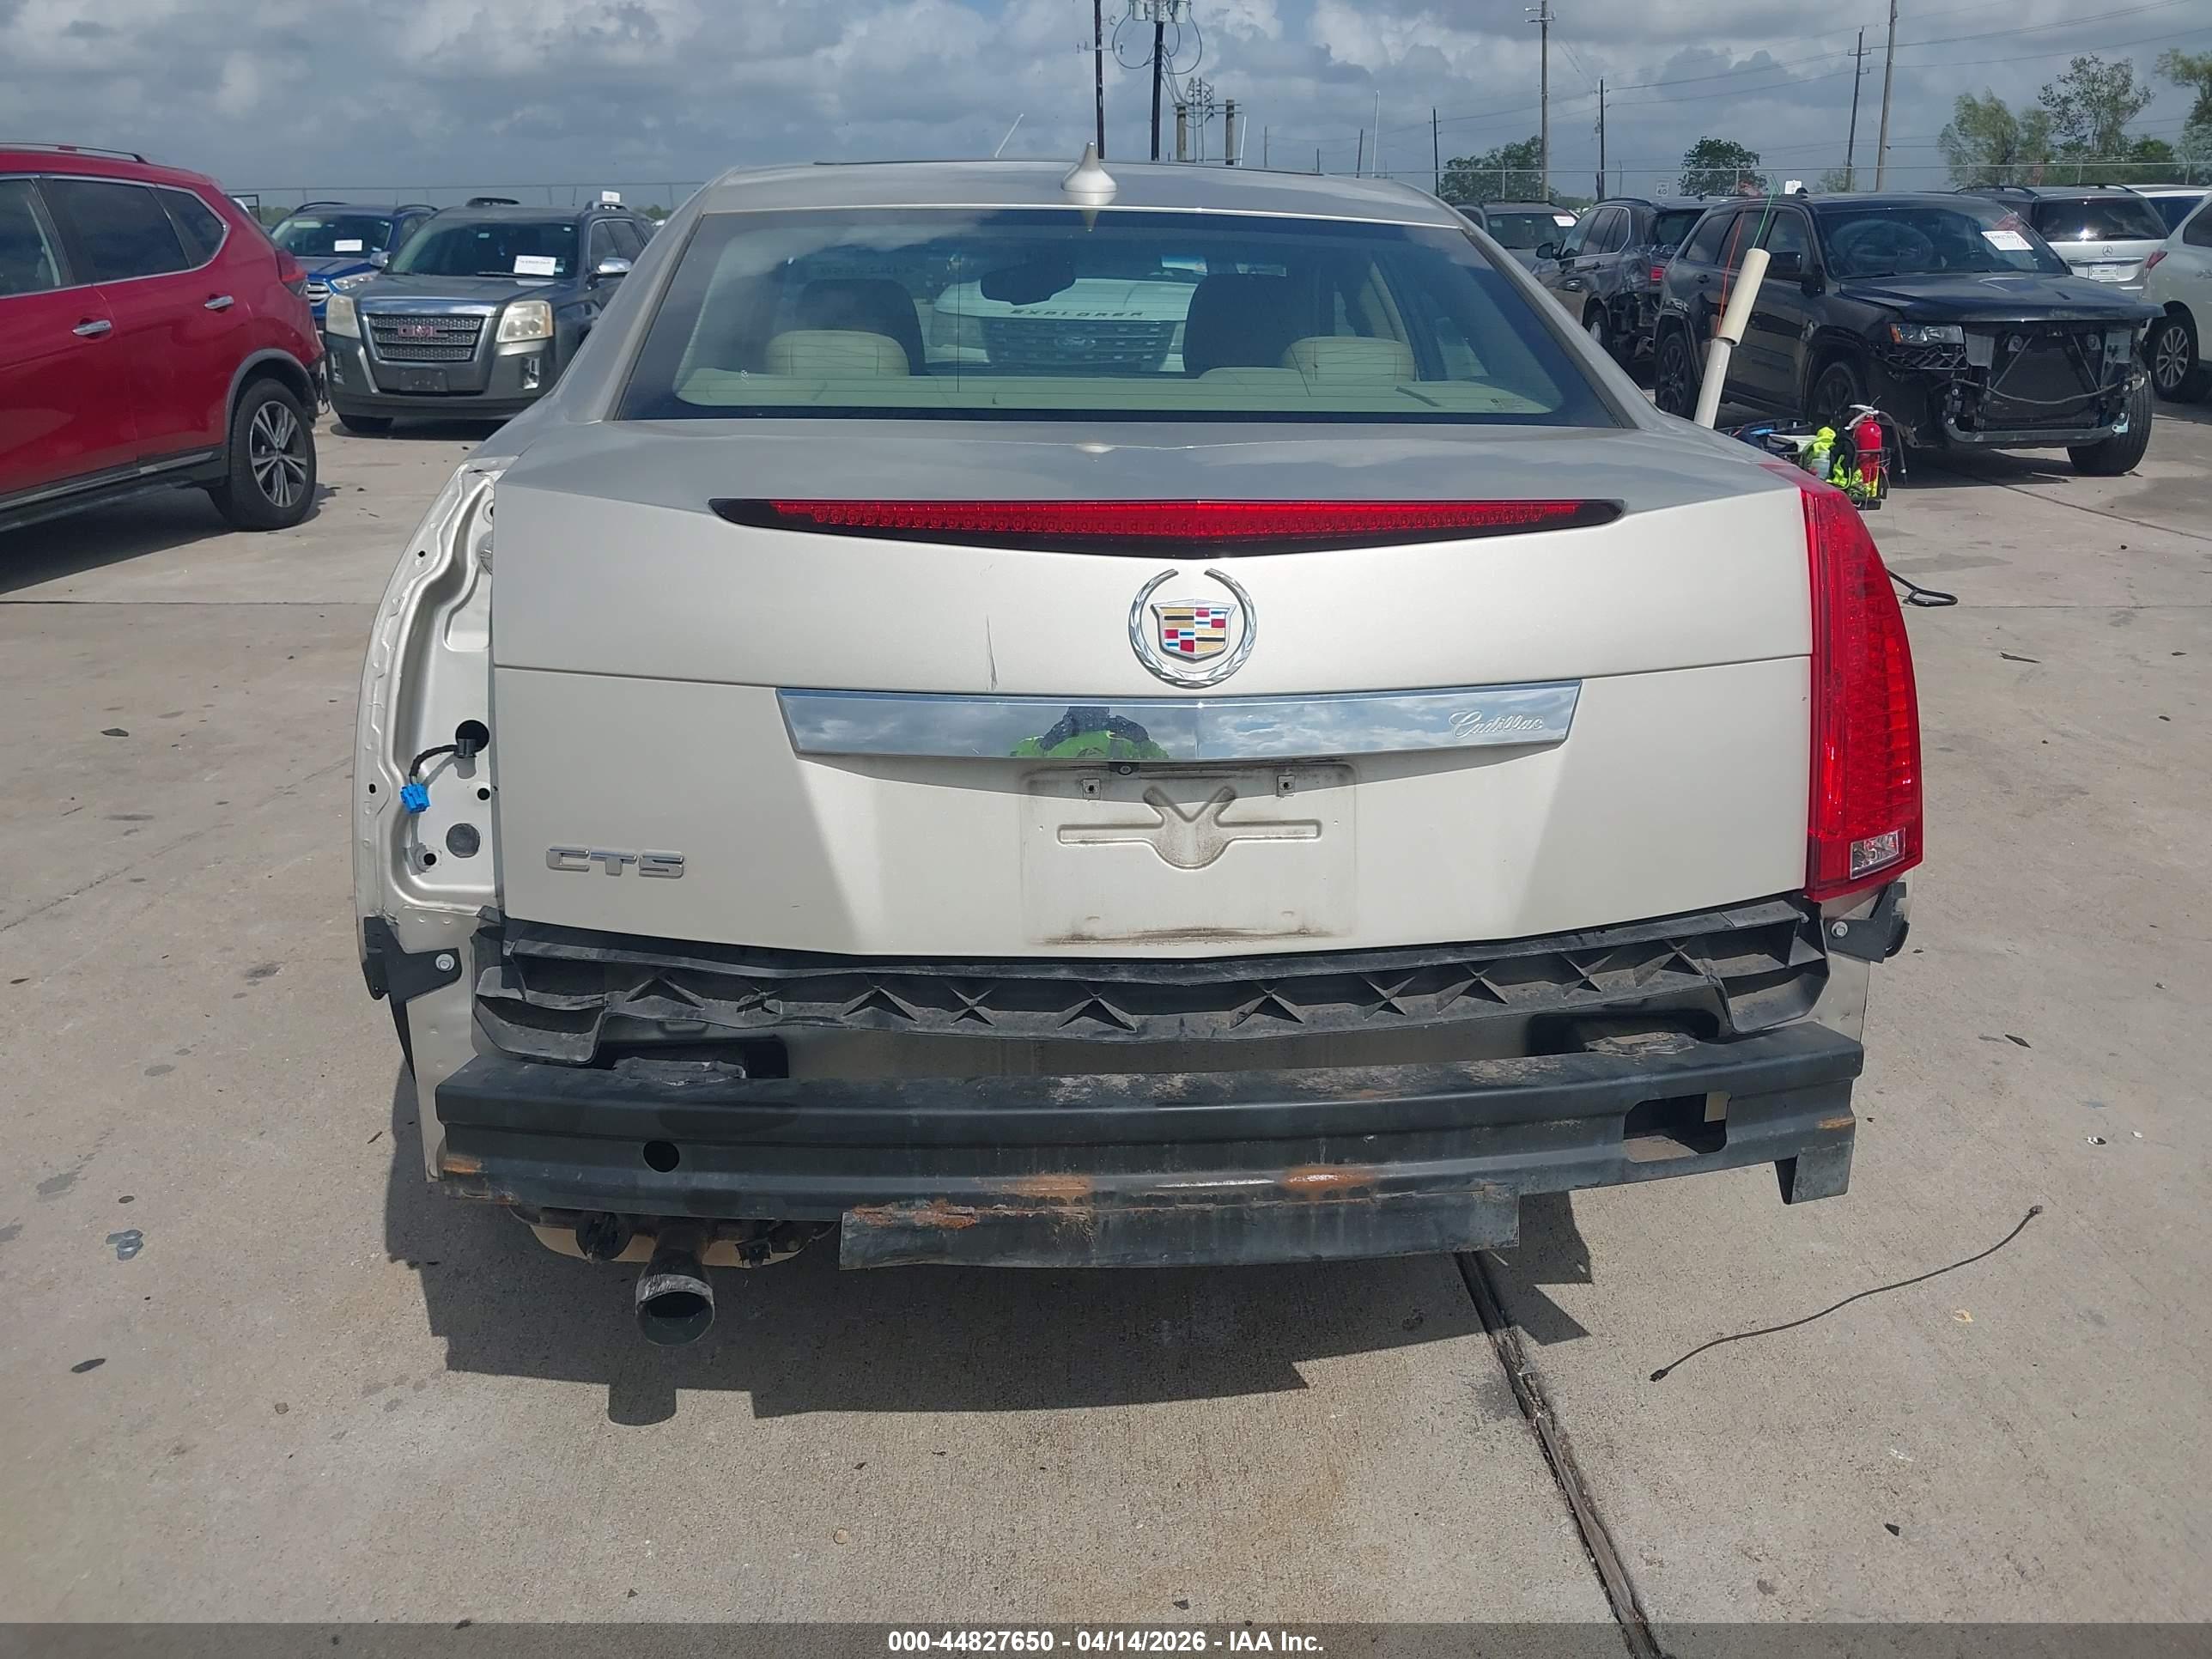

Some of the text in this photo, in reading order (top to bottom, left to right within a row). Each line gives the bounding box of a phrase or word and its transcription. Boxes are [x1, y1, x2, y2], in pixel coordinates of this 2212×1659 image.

[1011, 308, 1144, 318] EXPLORER
[398, 325, 449, 338] GMC
[1449, 710, 1543, 738] Cadillac
[545, 847, 684, 879] CTS
